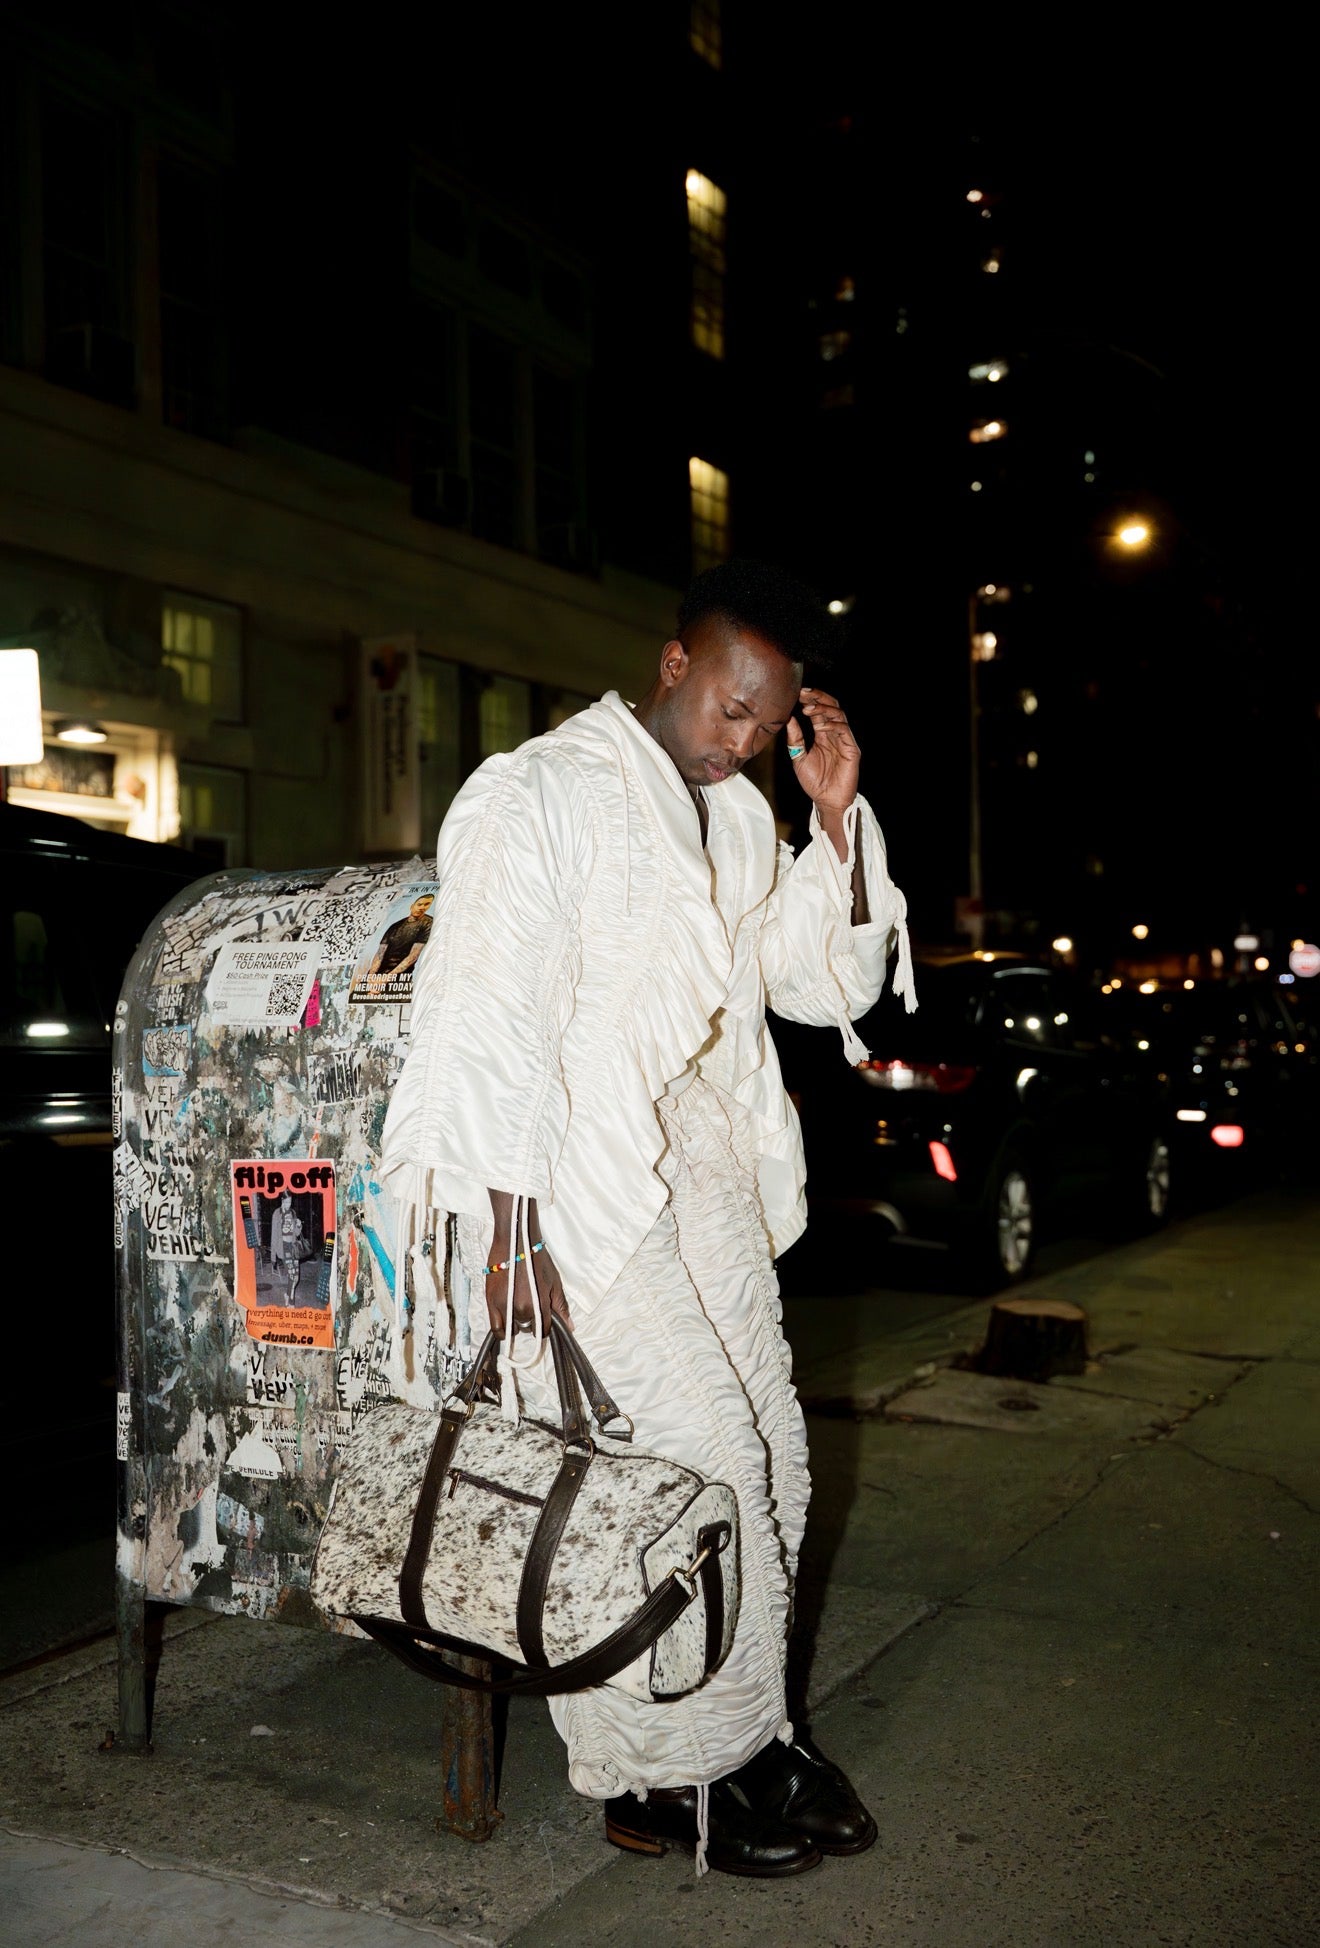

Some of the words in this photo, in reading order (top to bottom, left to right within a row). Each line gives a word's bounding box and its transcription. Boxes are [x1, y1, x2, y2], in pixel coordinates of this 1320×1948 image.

[232, 952, 256, 961] FREE
[256, 952, 279, 961] PING
[280, 952, 307, 961] PONG
[235, 961, 300, 969] TOURNAMENT
[356, 973, 398, 982] PREORDER
[399, 973, 412, 982] MY
[354, 982, 387, 992] MEMOIR
[388, 982, 414, 992] TODAY
[234, 1166, 284, 1194] flip
[248, 1309, 284, 1320] verything
[291, 1310, 307, 1319] need
[308, 1311, 313, 1320] 2
[314, 1313, 322, 1321] go
[261, 1331, 314, 1344] dumb.co
